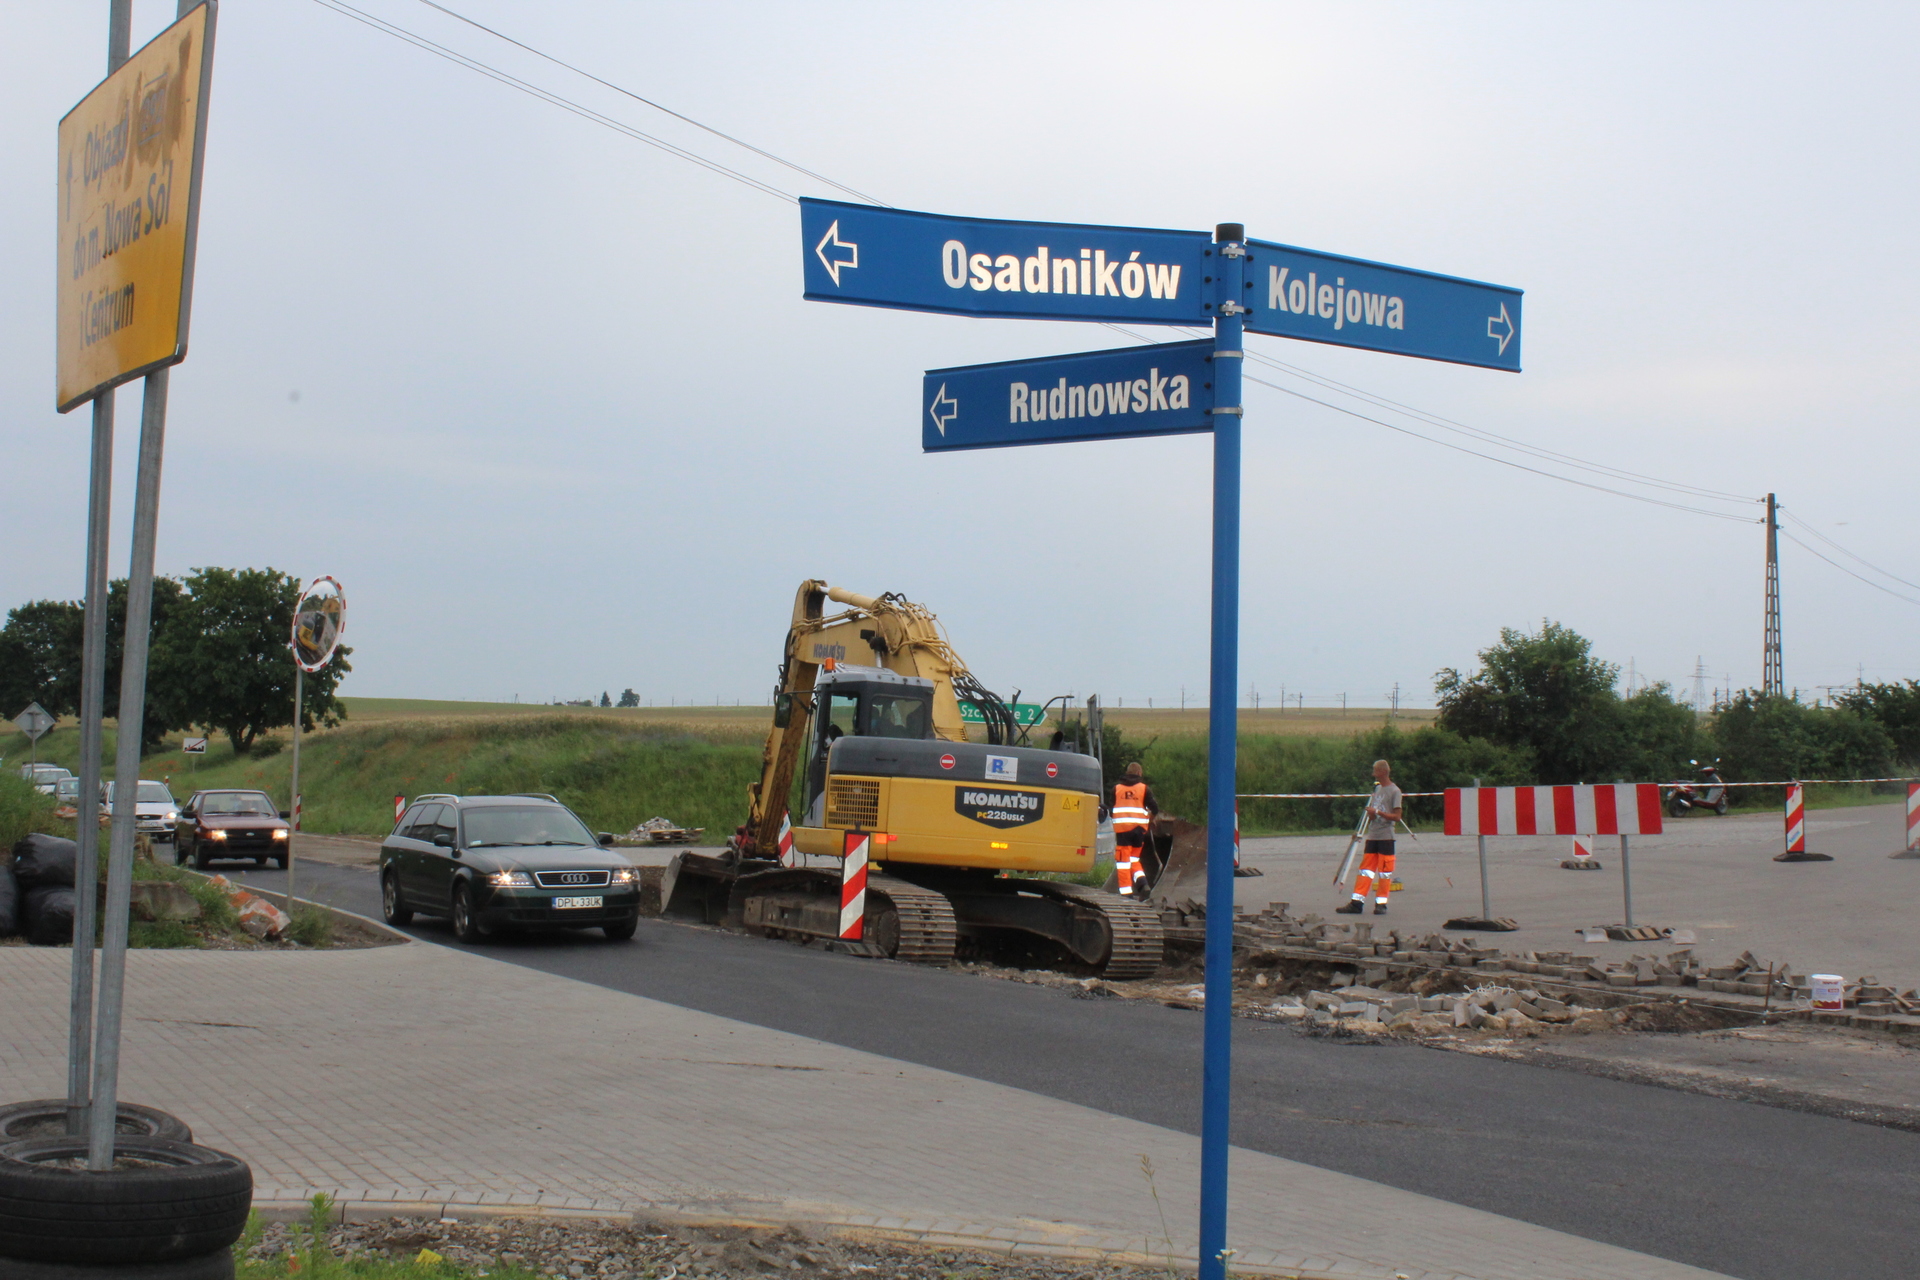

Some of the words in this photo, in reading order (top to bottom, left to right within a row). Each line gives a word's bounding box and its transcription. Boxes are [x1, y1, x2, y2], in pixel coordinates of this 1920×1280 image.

[83, 99, 130, 193] Objazd
[73, 222, 86, 280] do
[103, 197, 142, 256] Nowa
[144, 159, 174, 236] Sól
[941, 239, 1182, 300] Osadników
[1268, 264, 1404, 331] Kolejowa
[85, 281, 135, 347] Centrum
[1009, 367, 1190, 424] Rudnowska
[1027, 708, 1035, 720] 2
[963, 791, 1038, 810] KOMATSU
[976, 810, 1025, 822] PC228USLC
